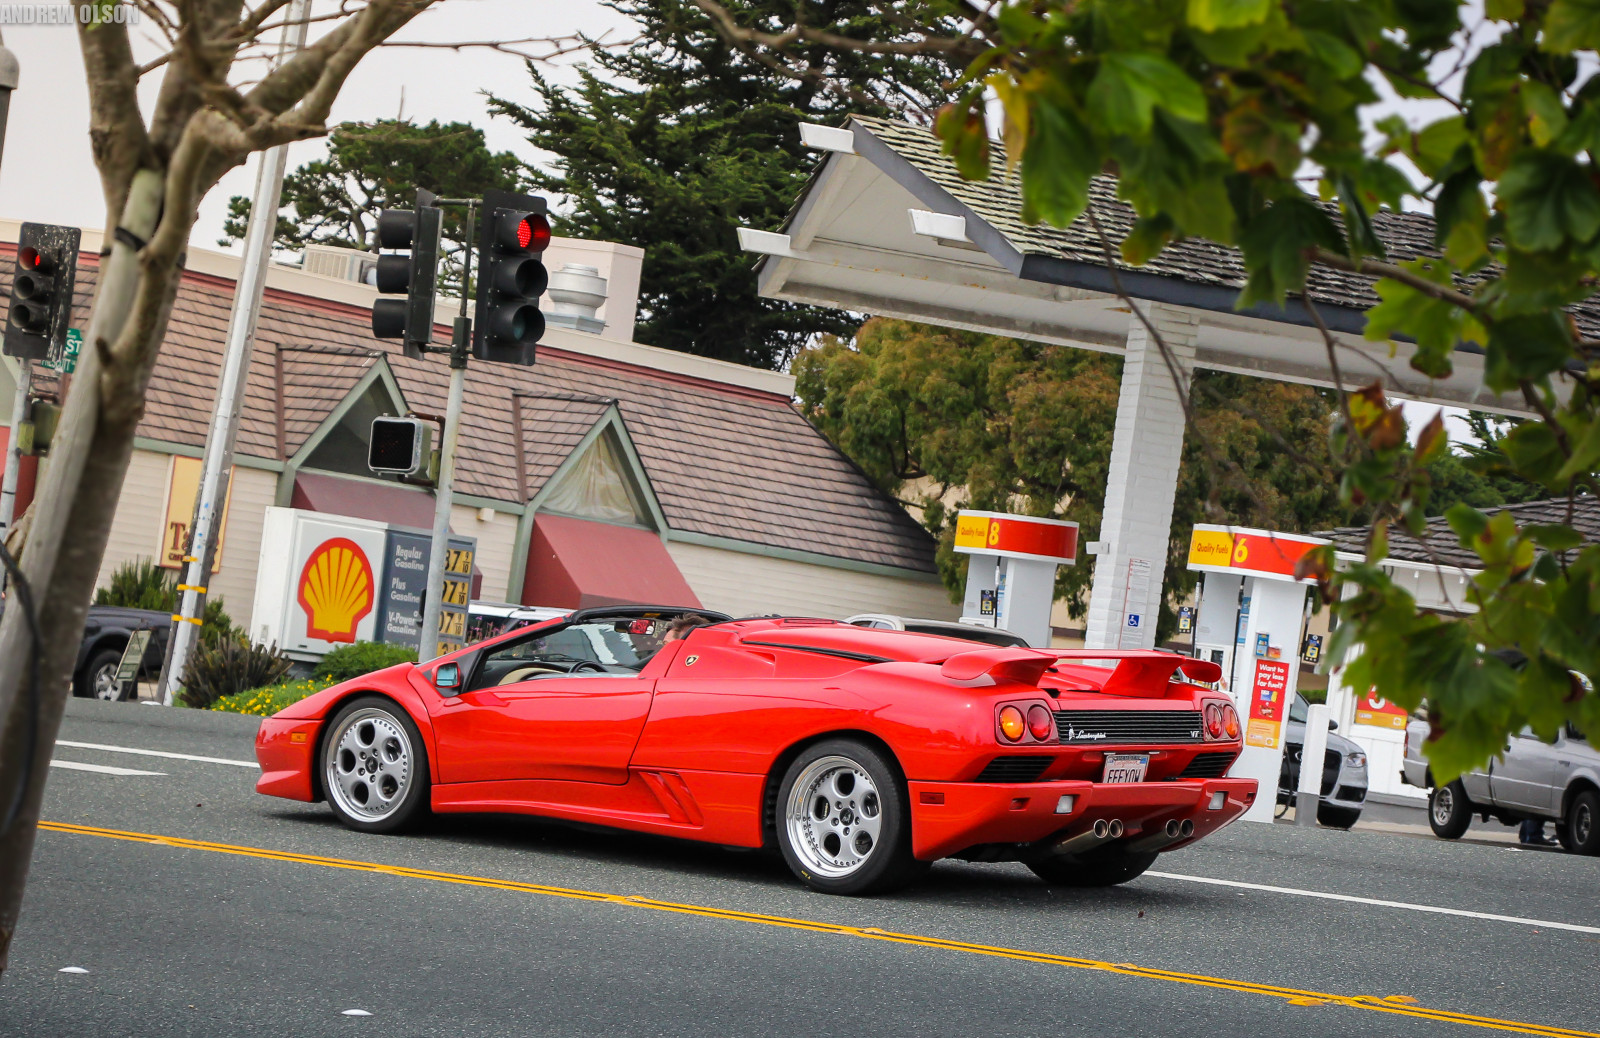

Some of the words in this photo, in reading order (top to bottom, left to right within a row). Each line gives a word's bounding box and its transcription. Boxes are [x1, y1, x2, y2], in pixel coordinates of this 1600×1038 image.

[65, 339, 83, 353] ST
[961, 527, 975, 538] Quality
[988, 521, 1000, 546] 8
[396, 545, 422, 560] Regular
[1197, 543, 1215, 556] Quality
[1216, 544, 1228, 554] Fuels
[1234, 537, 1248, 563] 6
[394, 558, 424, 571] Gasoline
[391, 577, 406, 590] Plus
[388, 611, 415, 626] V-Power
[386, 622, 417, 636] Gasoline
[1259, 664, 1277, 672] Want
[1257, 679, 1267, 687] for
[1259, 672, 1271, 680] pay
[1272, 673, 1285, 681] less
